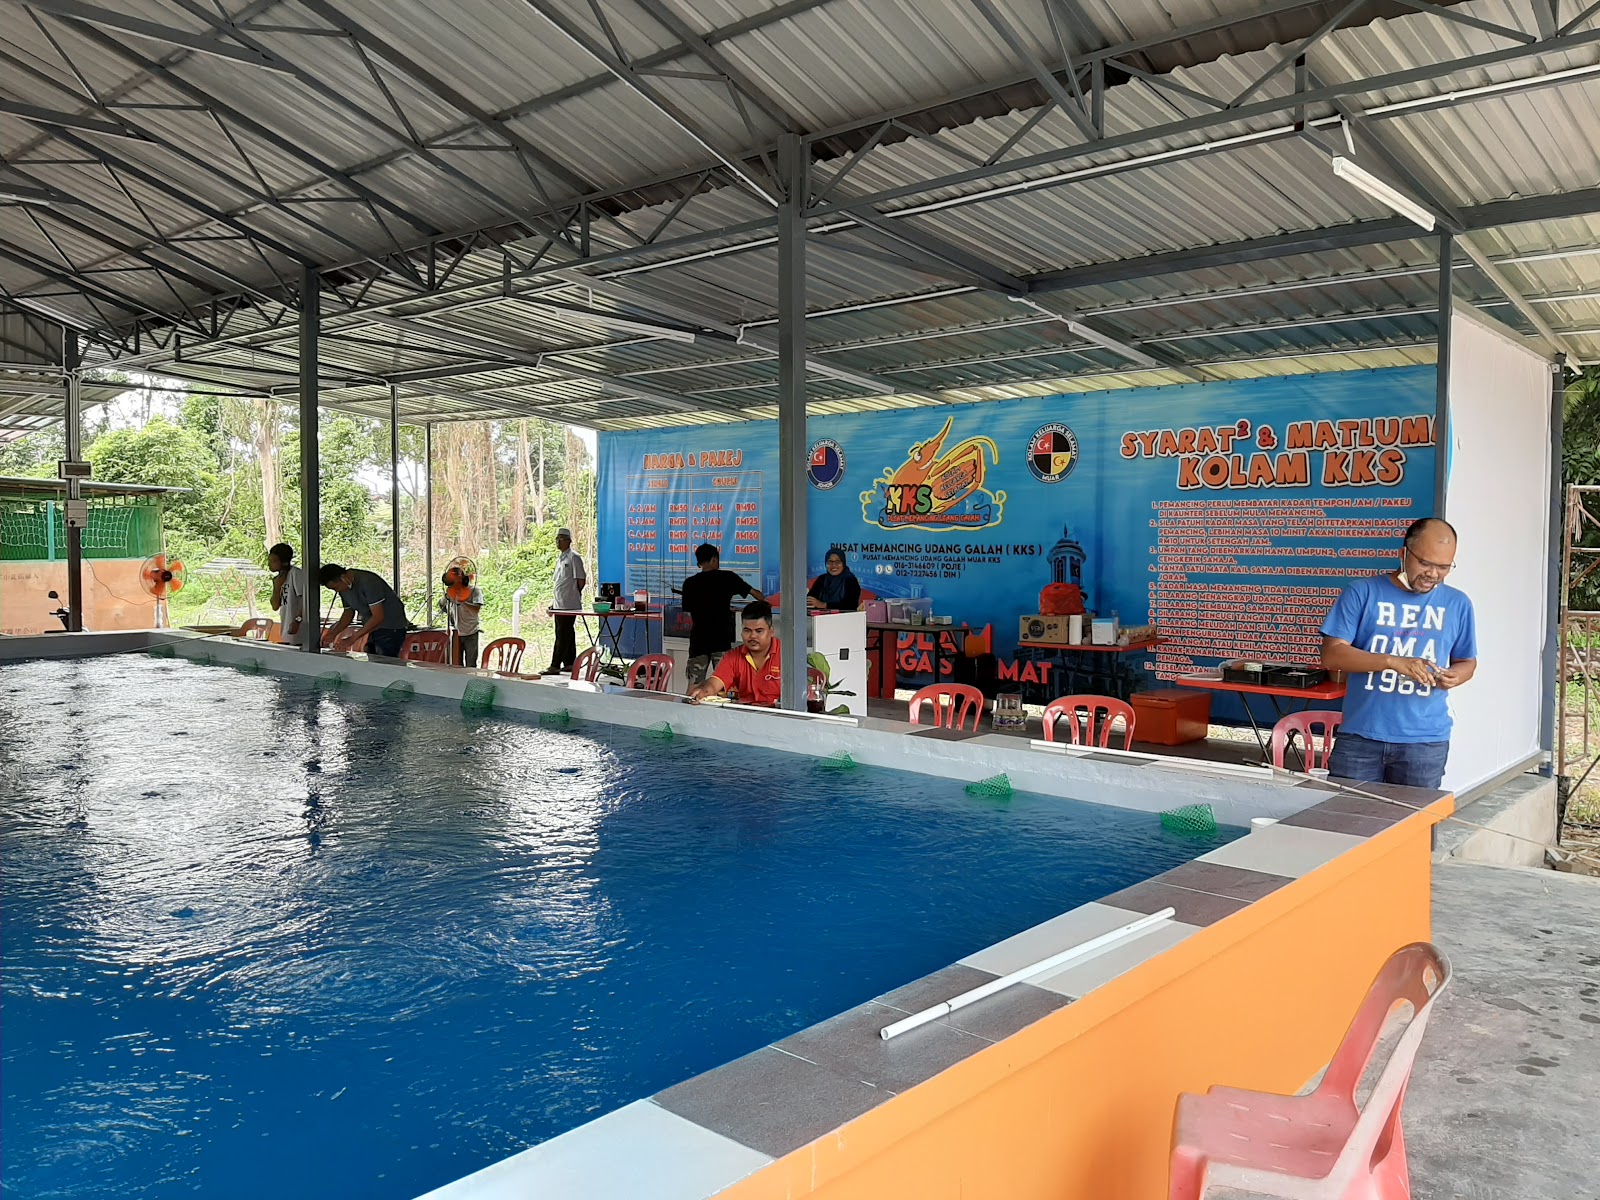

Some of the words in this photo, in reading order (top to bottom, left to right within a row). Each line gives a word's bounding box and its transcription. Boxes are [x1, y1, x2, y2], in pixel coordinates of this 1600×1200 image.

[1255, 423, 1278, 450] &
[643, 452, 685, 470] HARGA
[688, 453, 696, 467] &
[699, 449, 743, 469] PAKEJ
[1177, 452, 1311, 491] KOLAM
[1321, 448, 1407, 487] KKS
[885, 484, 932, 515] KKS
[1159, 501, 1206, 509] PEMANCING
[1207, 500, 1232, 508] PERLU
[1233, 499, 1279, 508] MEMBAYAR
[1281, 499, 1311, 507] KADAR
[1313, 498, 1352, 507] TEMPOH
[1352, 498, 1373, 507] JAM
[1374, 498, 1380, 507] /
[1381, 498, 1412, 507] PAKEJ
[1158, 510, 1167, 518] DI
[1168, 510, 1204, 518] KAUNTER
[1205, 510, 1241, 518] SEBELUM
[1242, 509, 1266, 517] MULA
[1149, 519, 1157, 528] 2.
[1158, 519, 1177, 527] SILA
[1177, 519, 1205, 527] PATUHI
[1205, 519, 1234, 527] KADAR
[1234, 519, 1259, 527] MASA
[1261, 519, 1284, 527] YANG
[1287, 519, 1315, 527] TELAH
[1316, 518, 1374, 527] DITETAPKAN
[1374, 518, 1398, 527] BAGI
[707, 530, 722, 540] JAM
[1208, 528, 1243, 537] LEBIHAN
[1244, 528, 1269, 537] MASA
[1270, 528, 1281, 536] 10
[1281, 528, 1307, 536] MINIT
[1308, 528, 1335, 537] AKAN
[1335, 528, 1392, 537] DIKENAKAN
[1393, 528, 1407, 538] CA
[1179, 537, 1206, 546] UNTUK
[1206, 537, 1249, 546] SETENGAH
[1250, 537, 1272, 546] JAM.
[861, 543, 922, 554] MEMANCING
[925, 544, 961, 555] UDANG
[965, 544, 1002, 555] GALAH
[1013, 545, 1035, 556] KKS
[1149, 546, 1157, 554] 3.
[1158, 546, 1186, 555] UMPAN
[1187, 547, 1209, 555] YANG
[1210, 547, 1263, 556] DIBENARKAN
[1264, 547, 1295, 556] HANYA
[1338, 548, 1376, 558] CACING
[1377, 549, 1399, 558] DAN
[988, 556, 1001, 564] KKS
[1158, 555, 1202, 563] CENGKERIK
[1202, 556, 1237, 564] SAHAJA.
[1148, 564, 1157, 573] 4.
[1158, 564, 1185, 573] HANYA
[1185, 565, 1205, 573] SATU
[1205, 565, 1229, 573] MATA
[1230, 565, 1249, 574] KAIL
[1250, 566, 1286, 575] SAHAJA
[1286, 567, 1346, 577] DIBENARKAN
[1346, 568, 1379, 578] UNTUK
[1149, 582, 1156, 590] 5.
[1158, 582, 1185, 591] KADAR
[1186, 583, 1208, 591] MASA
[1209, 583, 1261, 593] MEMANCING
[1263, 585, 1289, 594] TIDAK
[1290, 587, 1319, 595] BOLEH
[1148, 591, 1156, 600] 6.
[1157, 592, 1198, 600] DILARANG
[1199, 593, 1251, 603] MENANGKAP
[1252, 595, 1283, 603] UDANG
[1149, 600, 1156, 609] 7.
[1157, 601, 1198, 610] DILARANG
[1198, 602, 1246, 612] MEMBUANG
[1246, 603, 1282, 612] SAMPAH
[1283, 606, 1327, 616] KEDALAM
[1148, 609, 1156, 618] 8.
[1157, 610, 1198, 619] DILARANG
[1198, 611, 1235, 620] MENCUCI
[1236, 613, 1271, 622] TANGAN
[1272, 615, 1295, 624] ATAU
[1376, 601, 1446, 630] REN
[1157, 619, 1198, 628] DILARANG
[1198, 620, 1236, 630] MELUDAH
[1236, 622, 1256, 631] DAN
[1257, 623, 1276, 632] SILA
[1277, 624, 1302, 633] JAGA
[1157, 628, 1181, 636] PIHAK
[1181, 628, 1234, 639] PENGURUSAN
[1235, 631, 1260, 640] TIDAK
[1261, 633, 1287, 642] AKAN
[1156, 645, 1213, 656] KANAK-KANAK
[1214, 648, 1254, 659] MESTILAH
[1255, 651, 1287, 662] DALAM
[1211, 639, 1233, 648] ATAU
[1233, 640, 1289, 652] KEHILANGAN
[1289, 645, 1320, 655] HARTA
[1370, 634, 1437, 663] OMA
[1144, 662, 1155, 670] 12.
[1156, 662, 1211, 674] KESELAMATAN
